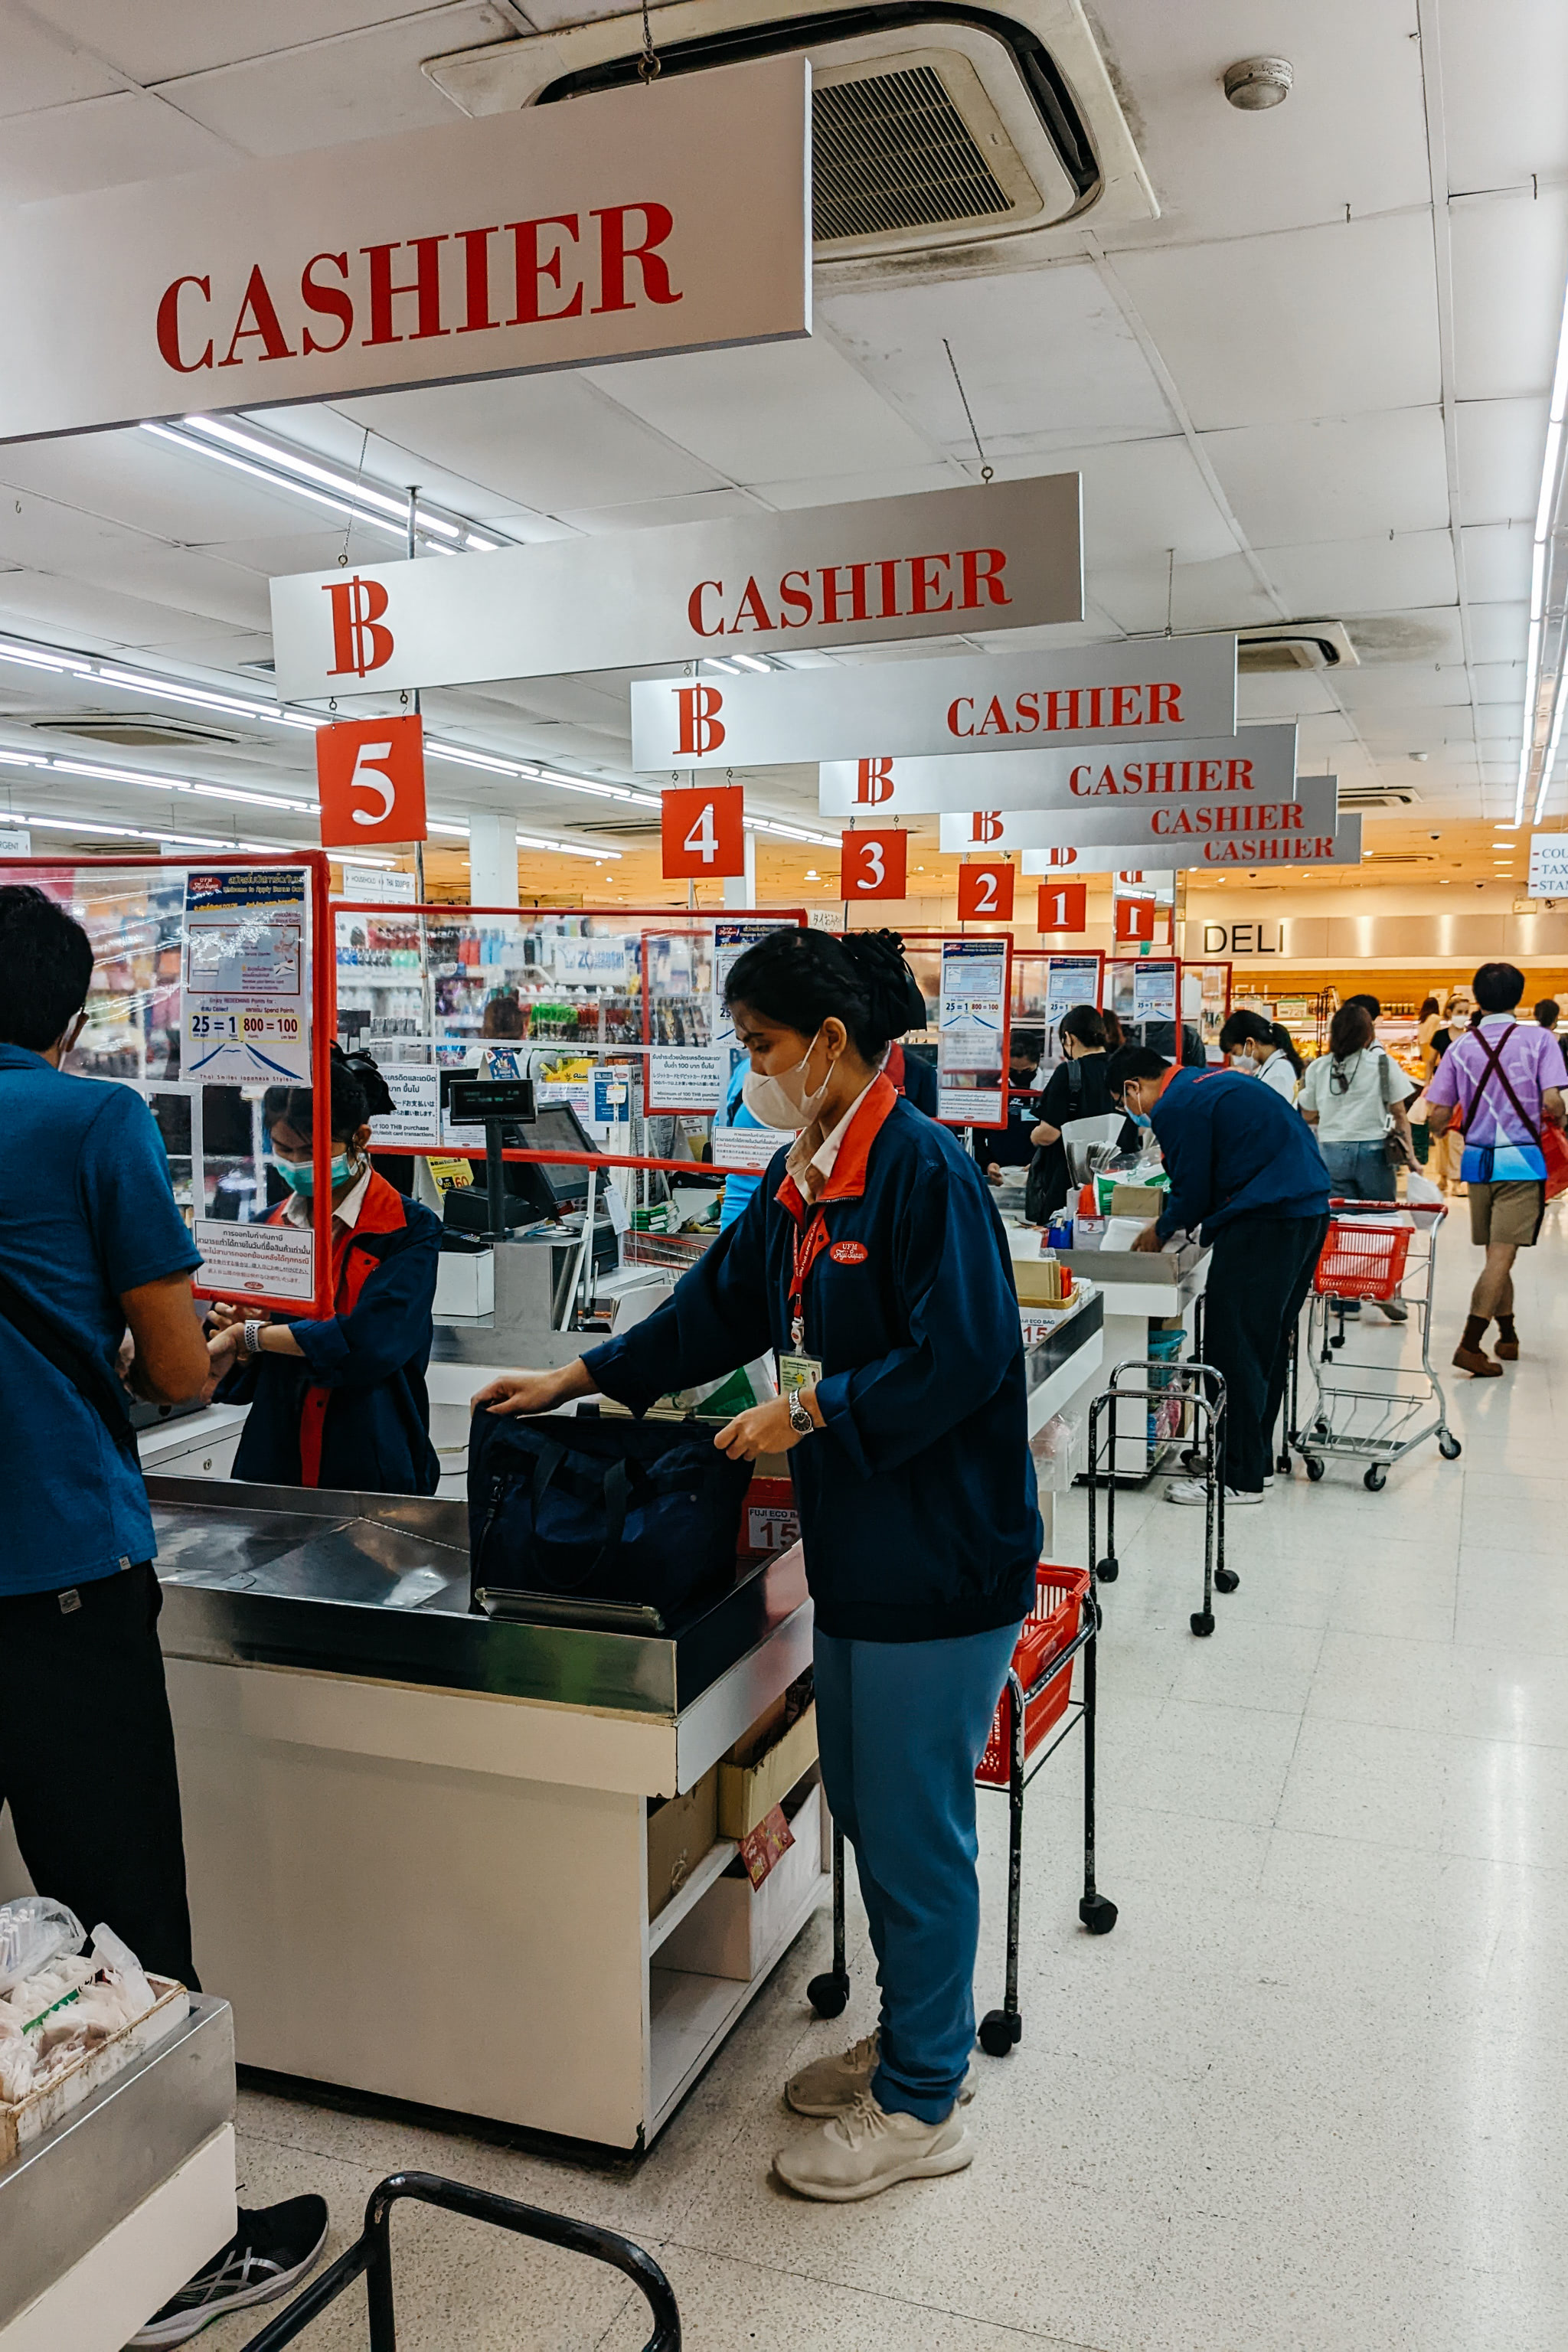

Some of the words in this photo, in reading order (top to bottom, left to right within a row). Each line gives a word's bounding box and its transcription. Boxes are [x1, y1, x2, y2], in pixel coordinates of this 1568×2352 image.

[156, 201, 683, 373] CASHIER
[688, 547, 1012, 637] CASHIER
[946, 683, 1184, 737] CASHIER
[351, 742, 395, 825] 5
[1069, 759, 1256, 797] CASHIER
[684, 803, 720, 864] 4
[1151, 804, 1304, 835] CASHIER
[1204, 837, 1334, 861] CASHIER
[857, 841, 885, 889] 3
[1541, 864, 1568, 874] TAX
[975, 873, 998, 912] 2
[1052, 892, 1070, 925] 1
[1204, 924, 1285, 953] DELI
[946, 1002, 956, 1011] 25
[192, 1015, 210, 1033] 25
[228, 1016, 236, 1034] 1
[243, 1018, 264, 1032] 800
[277, 1018, 298, 1033] 100
[833, 1249, 848, 1261] Fuji
[847, 1250, 864, 1261] Super
[1023, 1326, 1047, 1342] 15
[750, 1508, 767, 1517] FUJI
[760, 1521, 798, 1547] 15
